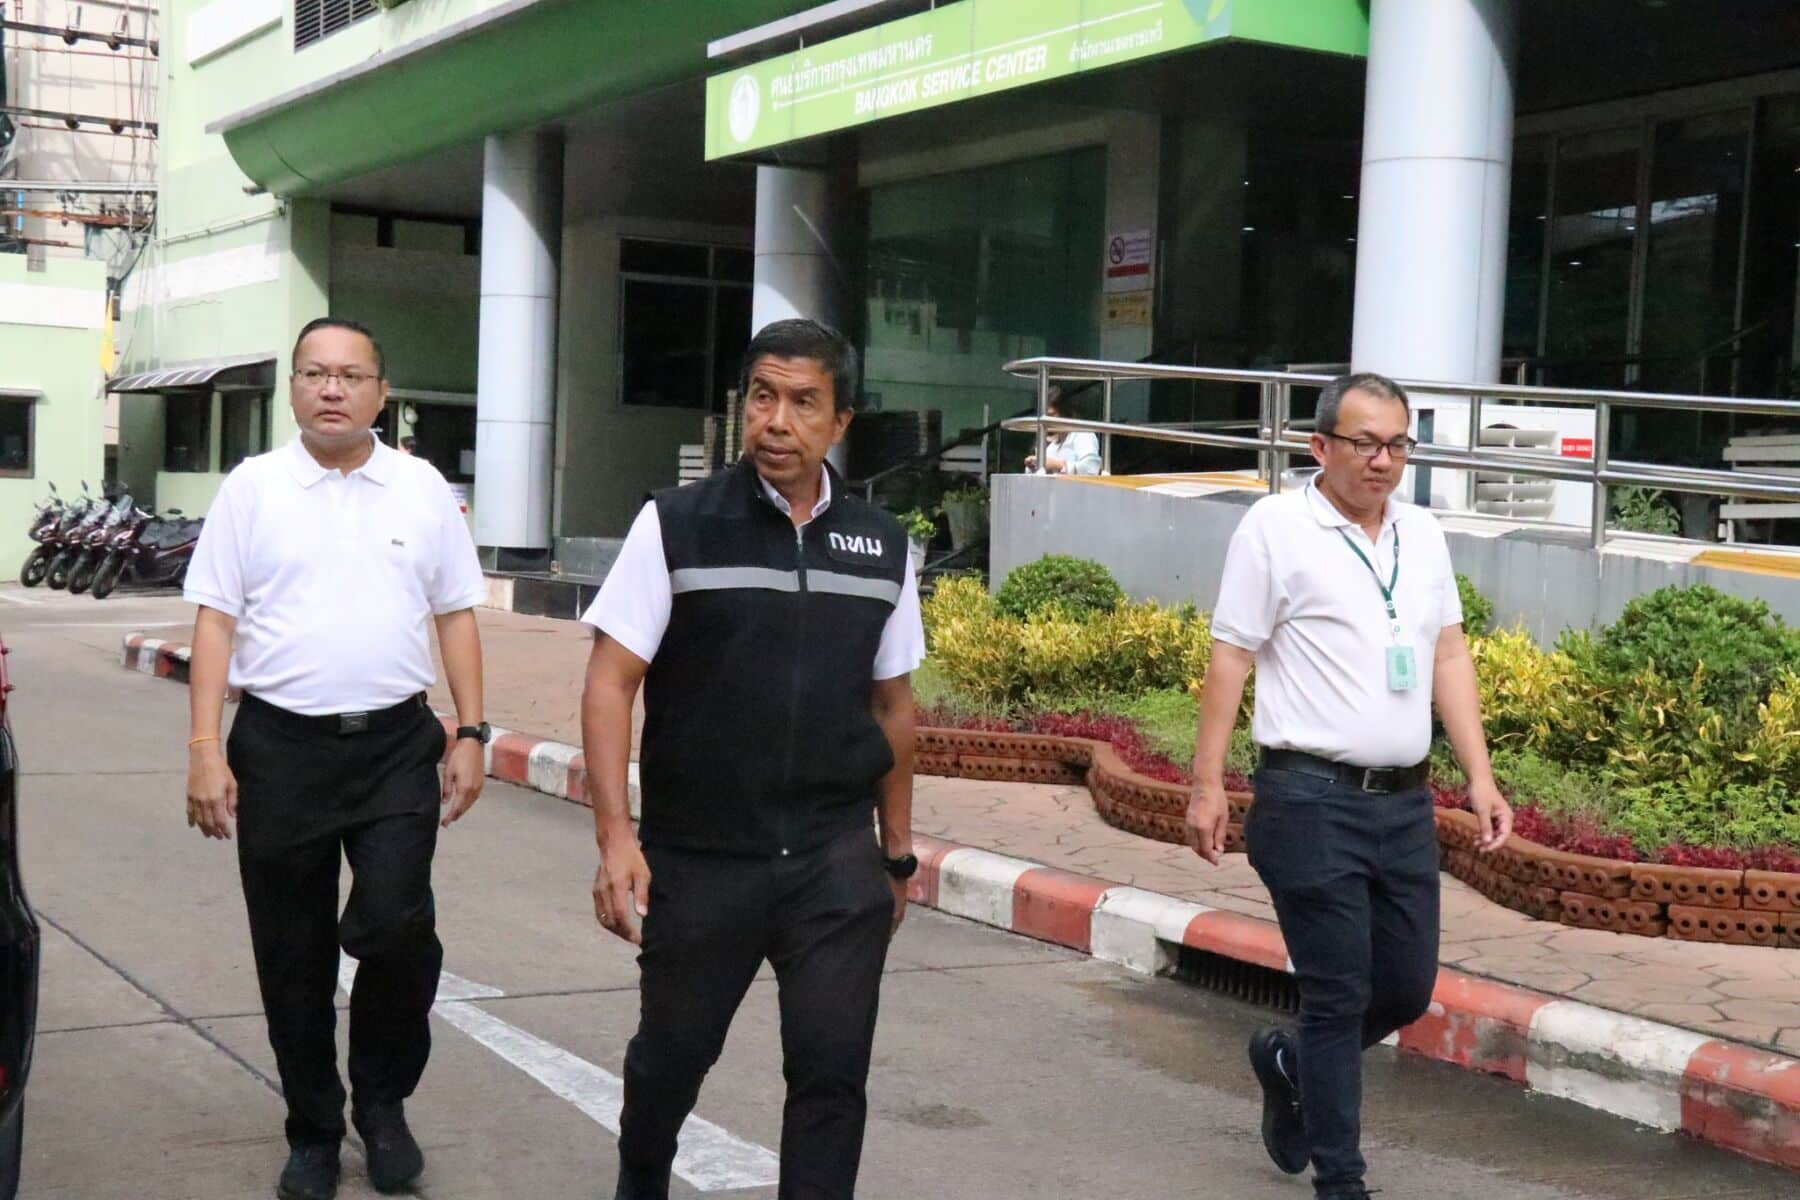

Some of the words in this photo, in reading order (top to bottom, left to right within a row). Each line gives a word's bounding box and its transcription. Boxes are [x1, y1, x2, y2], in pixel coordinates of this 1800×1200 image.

[855, 78, 918, 115] BANGKOK
[920, 60, 982, 98] SERVICE
[985, 43, 1048, 82] CENTER
[828, 531, 883, 558] กทม
